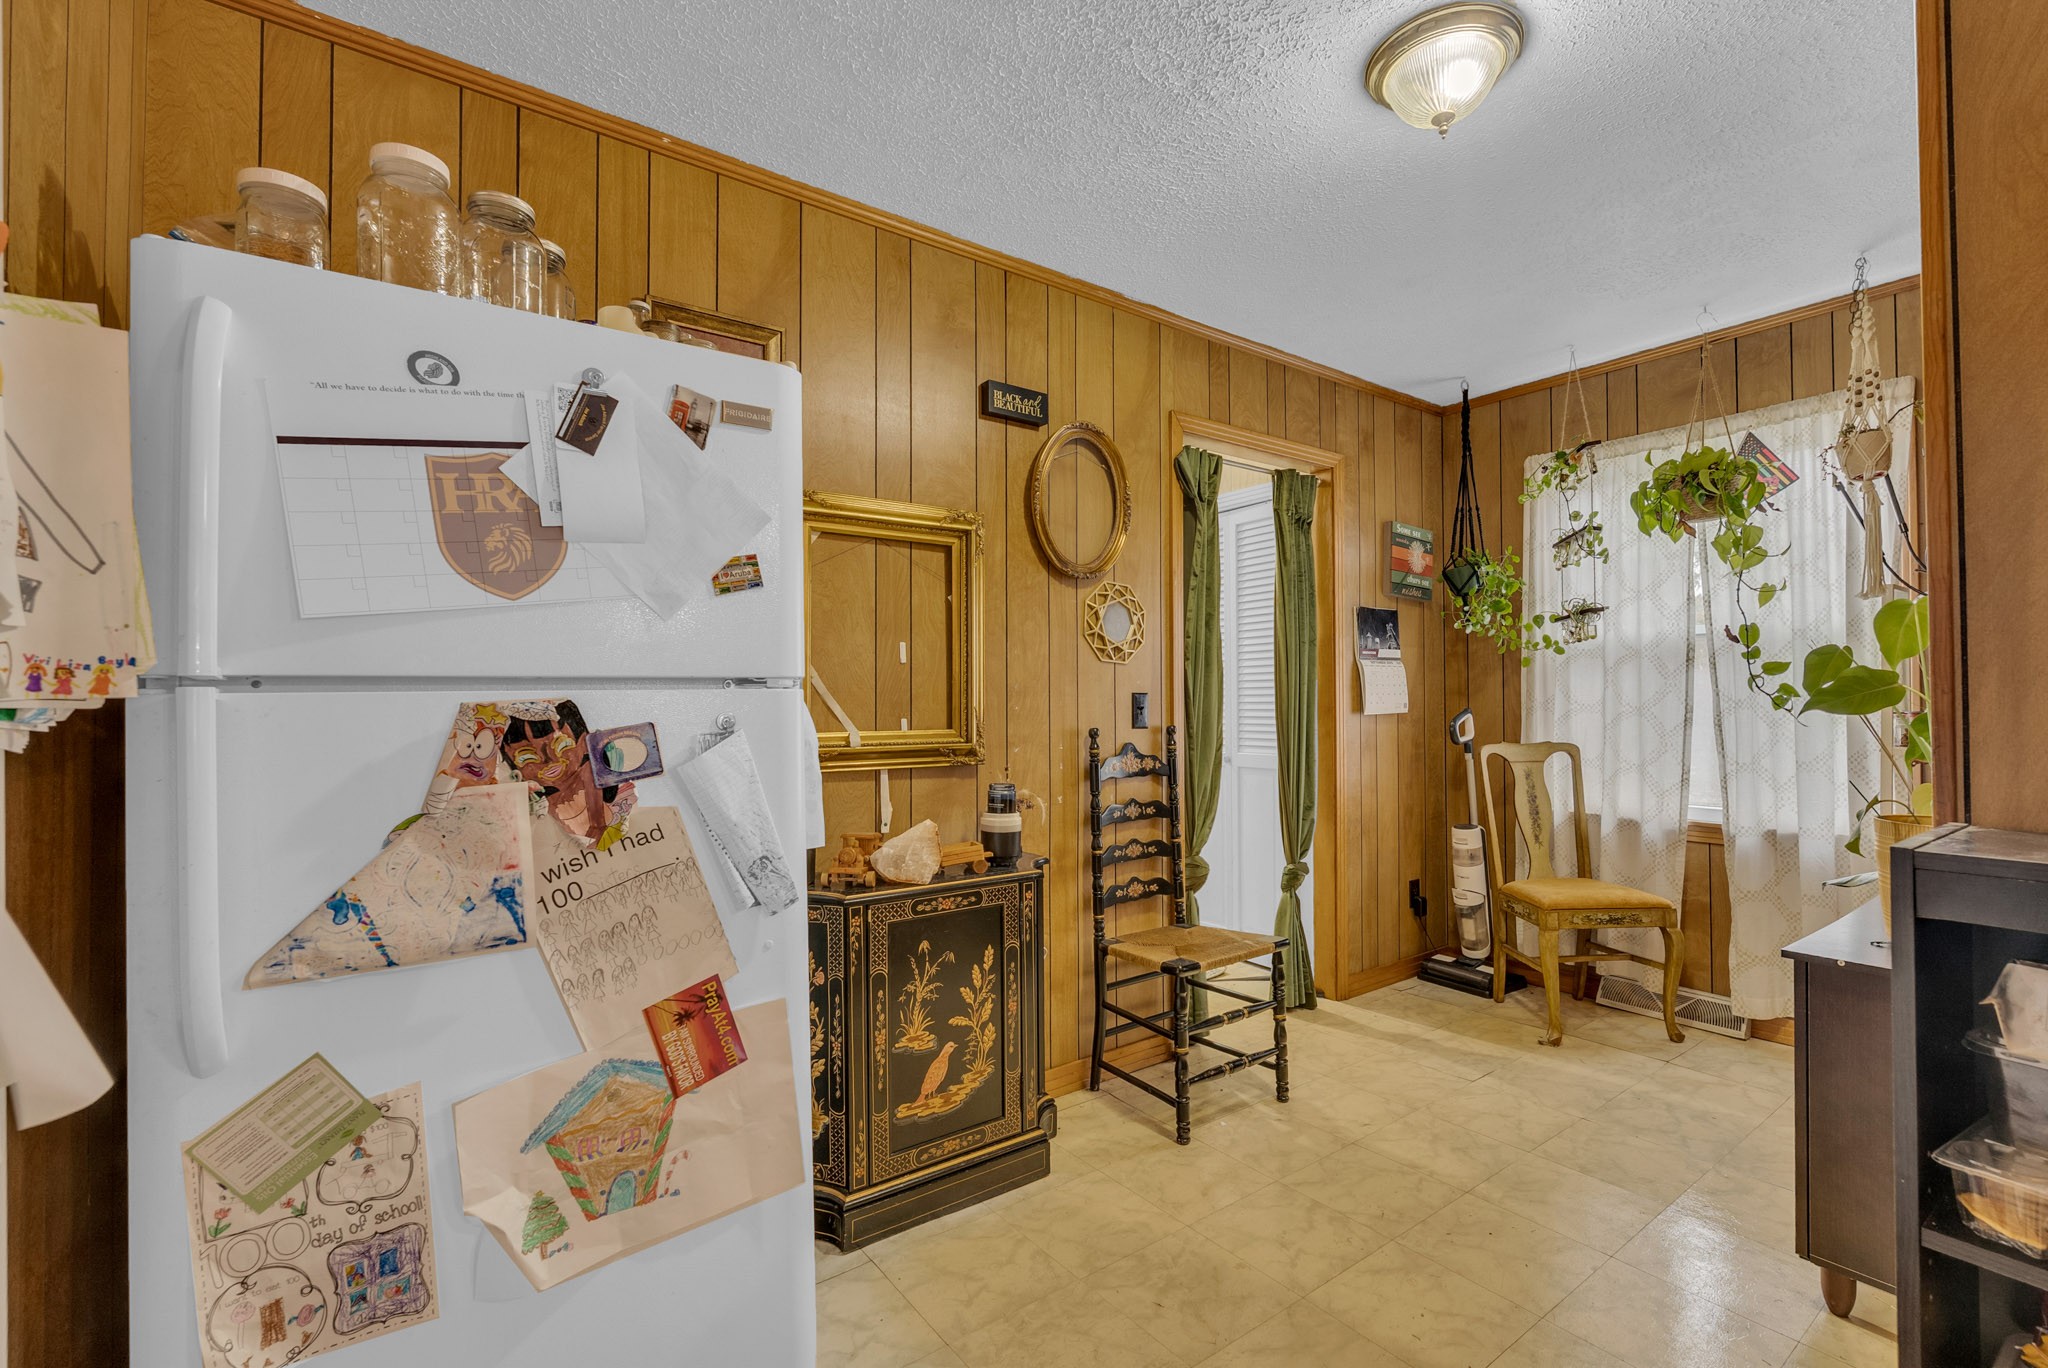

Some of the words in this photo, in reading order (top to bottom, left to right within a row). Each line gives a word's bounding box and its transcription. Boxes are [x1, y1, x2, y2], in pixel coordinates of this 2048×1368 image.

[379, 385, 407, 393] decide
[463, 389, 481, 397] with
[497, 391, 514, 399] time
[993, 389, 1022, 405] BLACK
[1022, 395, 1042, 408] and
[993, 399, 1043, 418] BEAUTIFUL
[729, 569, 752, 578] Aruba
[540, 849, 599, 884] wish
[536, 881, 583, 915] 100
[702, 980, 740, 1065] PrayAt4.com
[661, 1030, 679, 1045] BY
[673, 1062, 696, 1091] FAVOR
[682, 1037, 706, 1082] SURROUNDED
[311, 1228, 343, 1248] day
[349, 1214, 367, 1235] of
